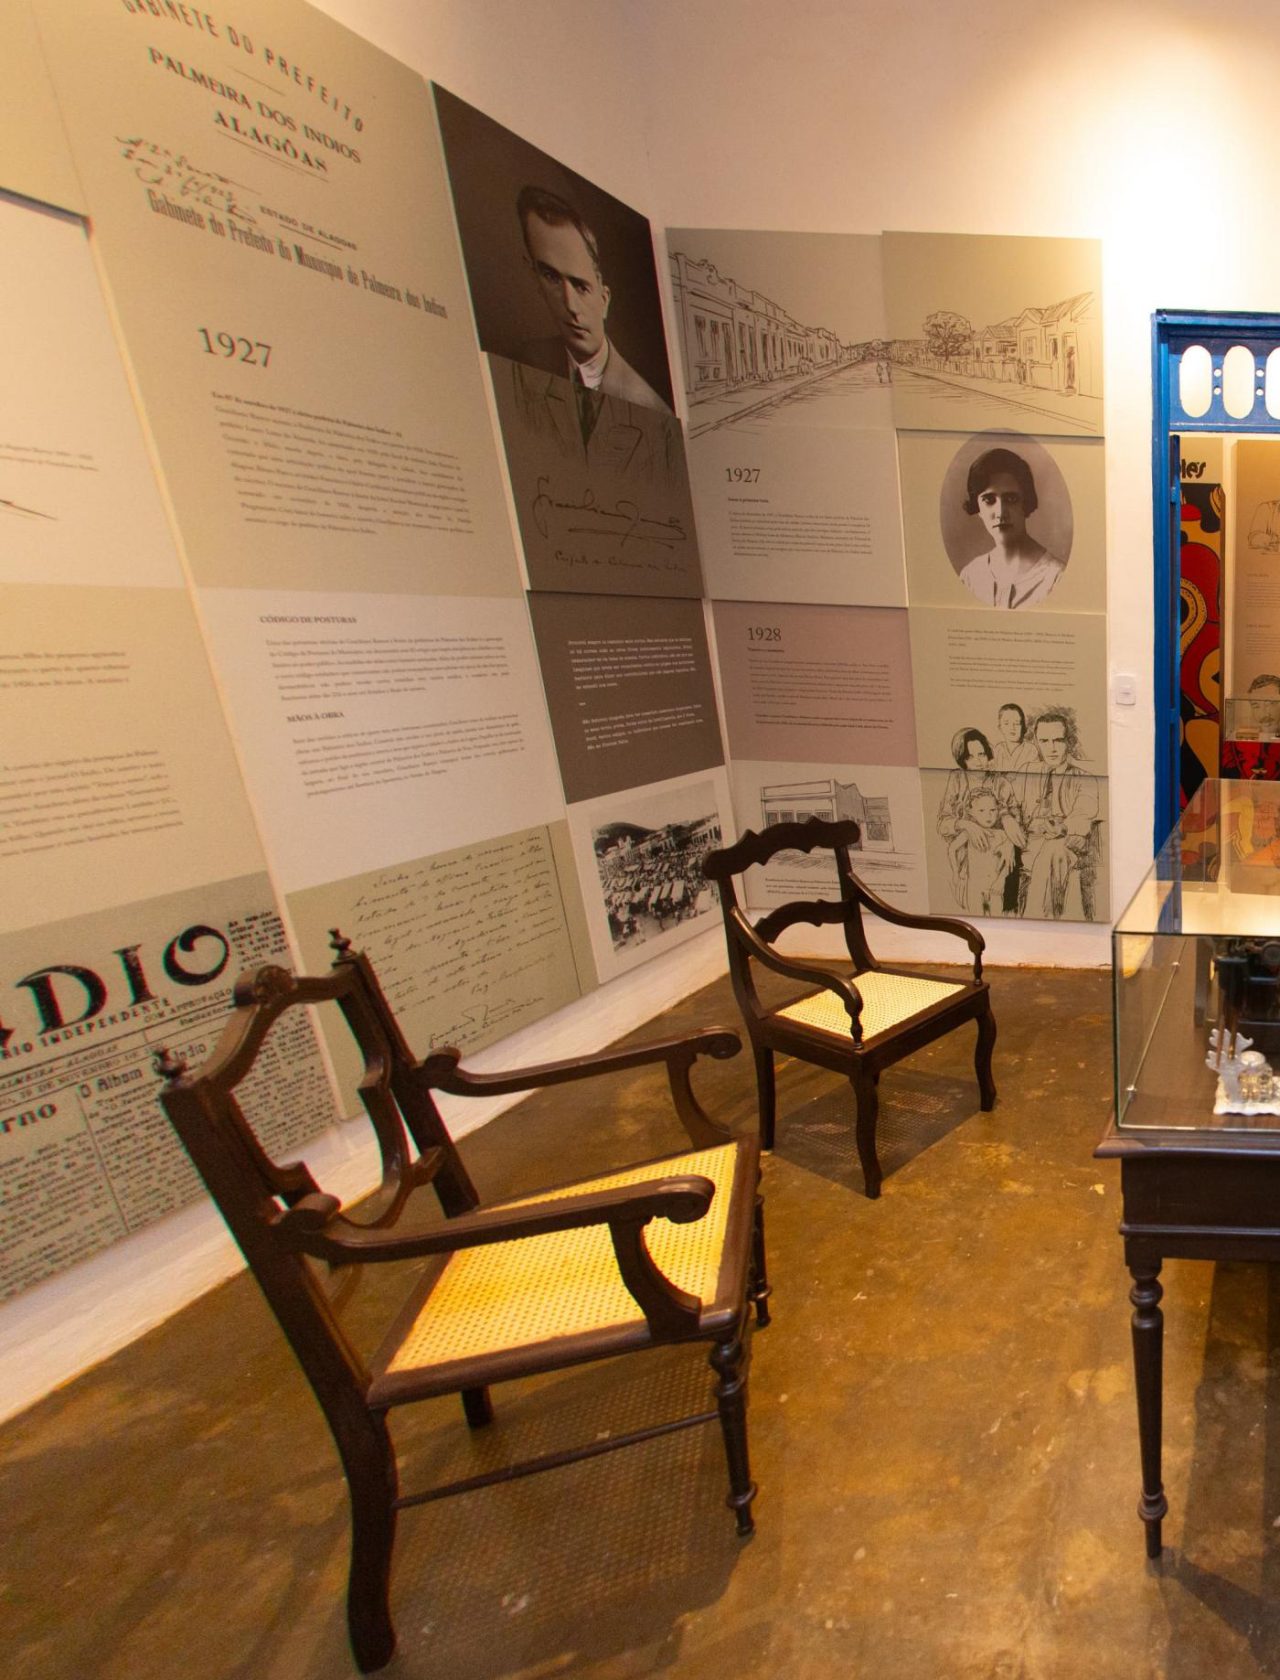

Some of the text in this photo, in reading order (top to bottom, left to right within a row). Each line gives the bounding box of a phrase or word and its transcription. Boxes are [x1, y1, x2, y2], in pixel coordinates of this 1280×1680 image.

[149, 46, 361, 163] PALMEIRA DOS INDIOS
[265, 48, 363, 132] PREFEITO
[197, 327, 272, 368] 1927
[725, 467, 761, 483] 1927
[747, 627, 782, 641] 1928
